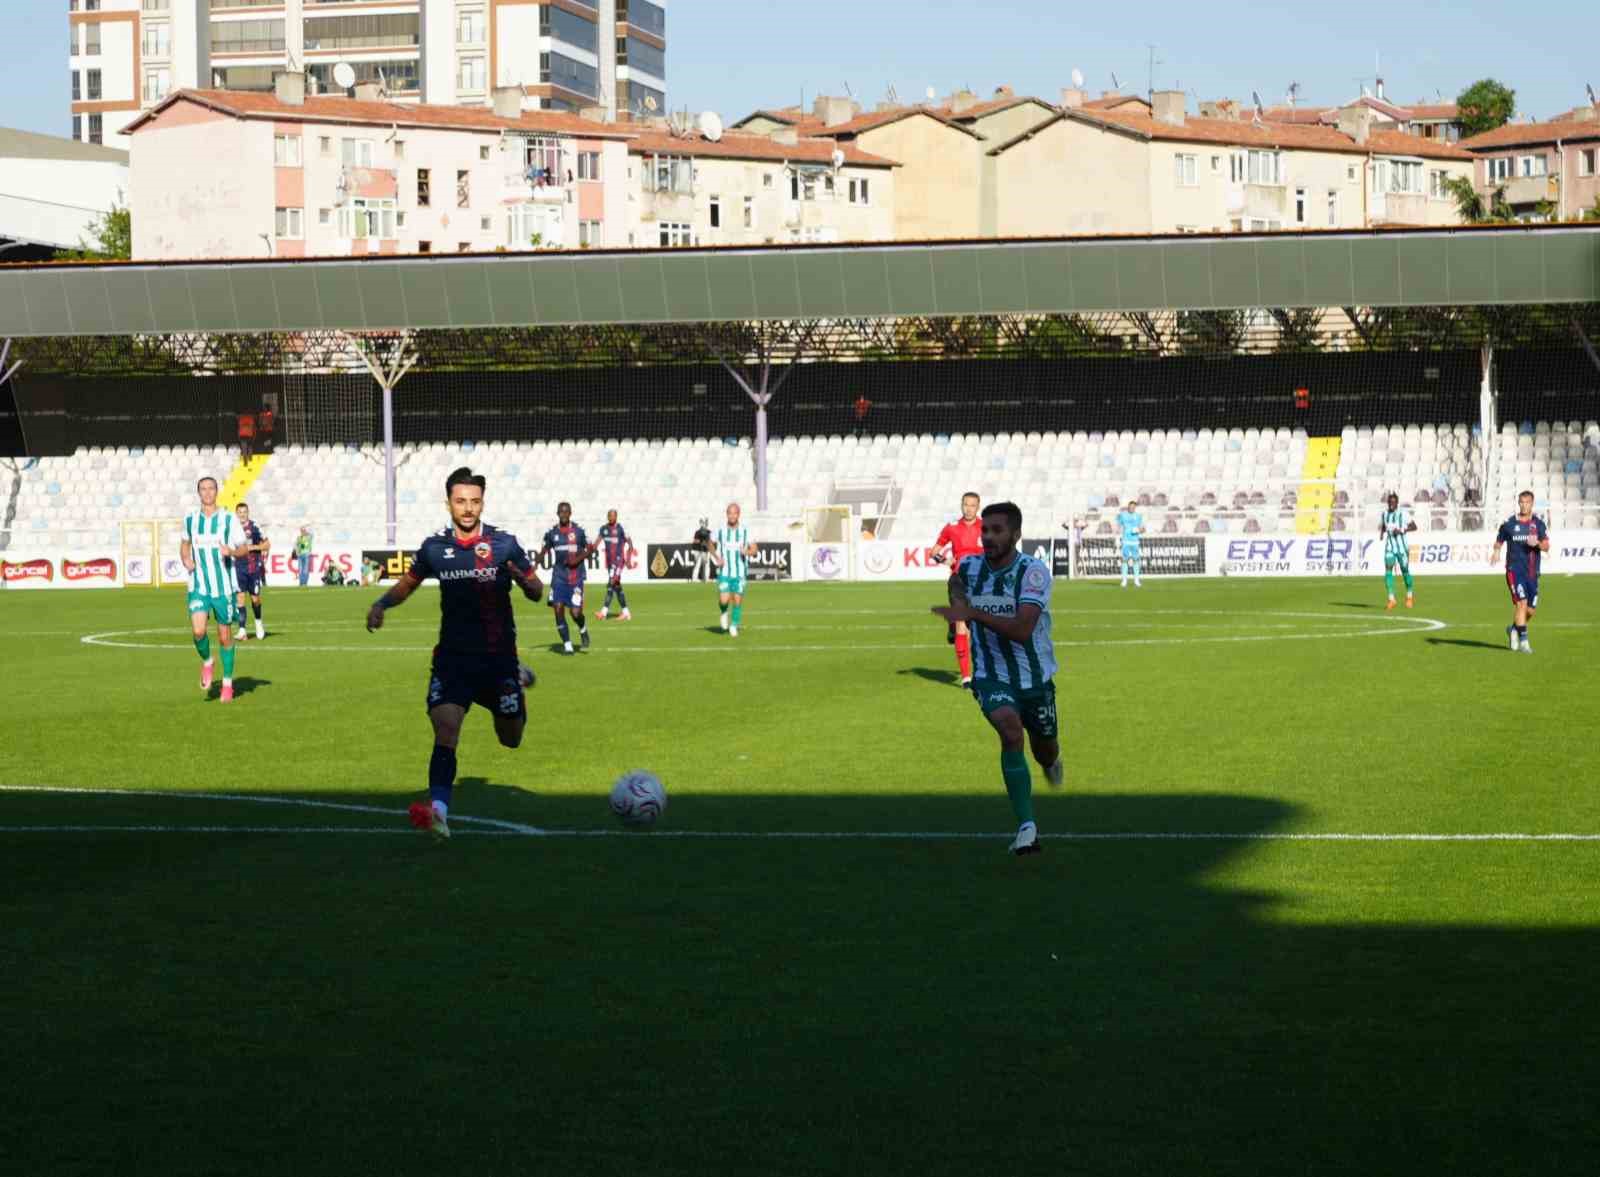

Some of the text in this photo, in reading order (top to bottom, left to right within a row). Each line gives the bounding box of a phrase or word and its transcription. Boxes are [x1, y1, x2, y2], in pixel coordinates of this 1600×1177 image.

[1227, 539, 1296, 559] ERY
[1305, 539, 1374, 559] ERY
[439, 567, 497, 580] MAHMOOD
[1229, 561, 1291, 572] SYSTEM
[500, 693, 519, 714] 25
